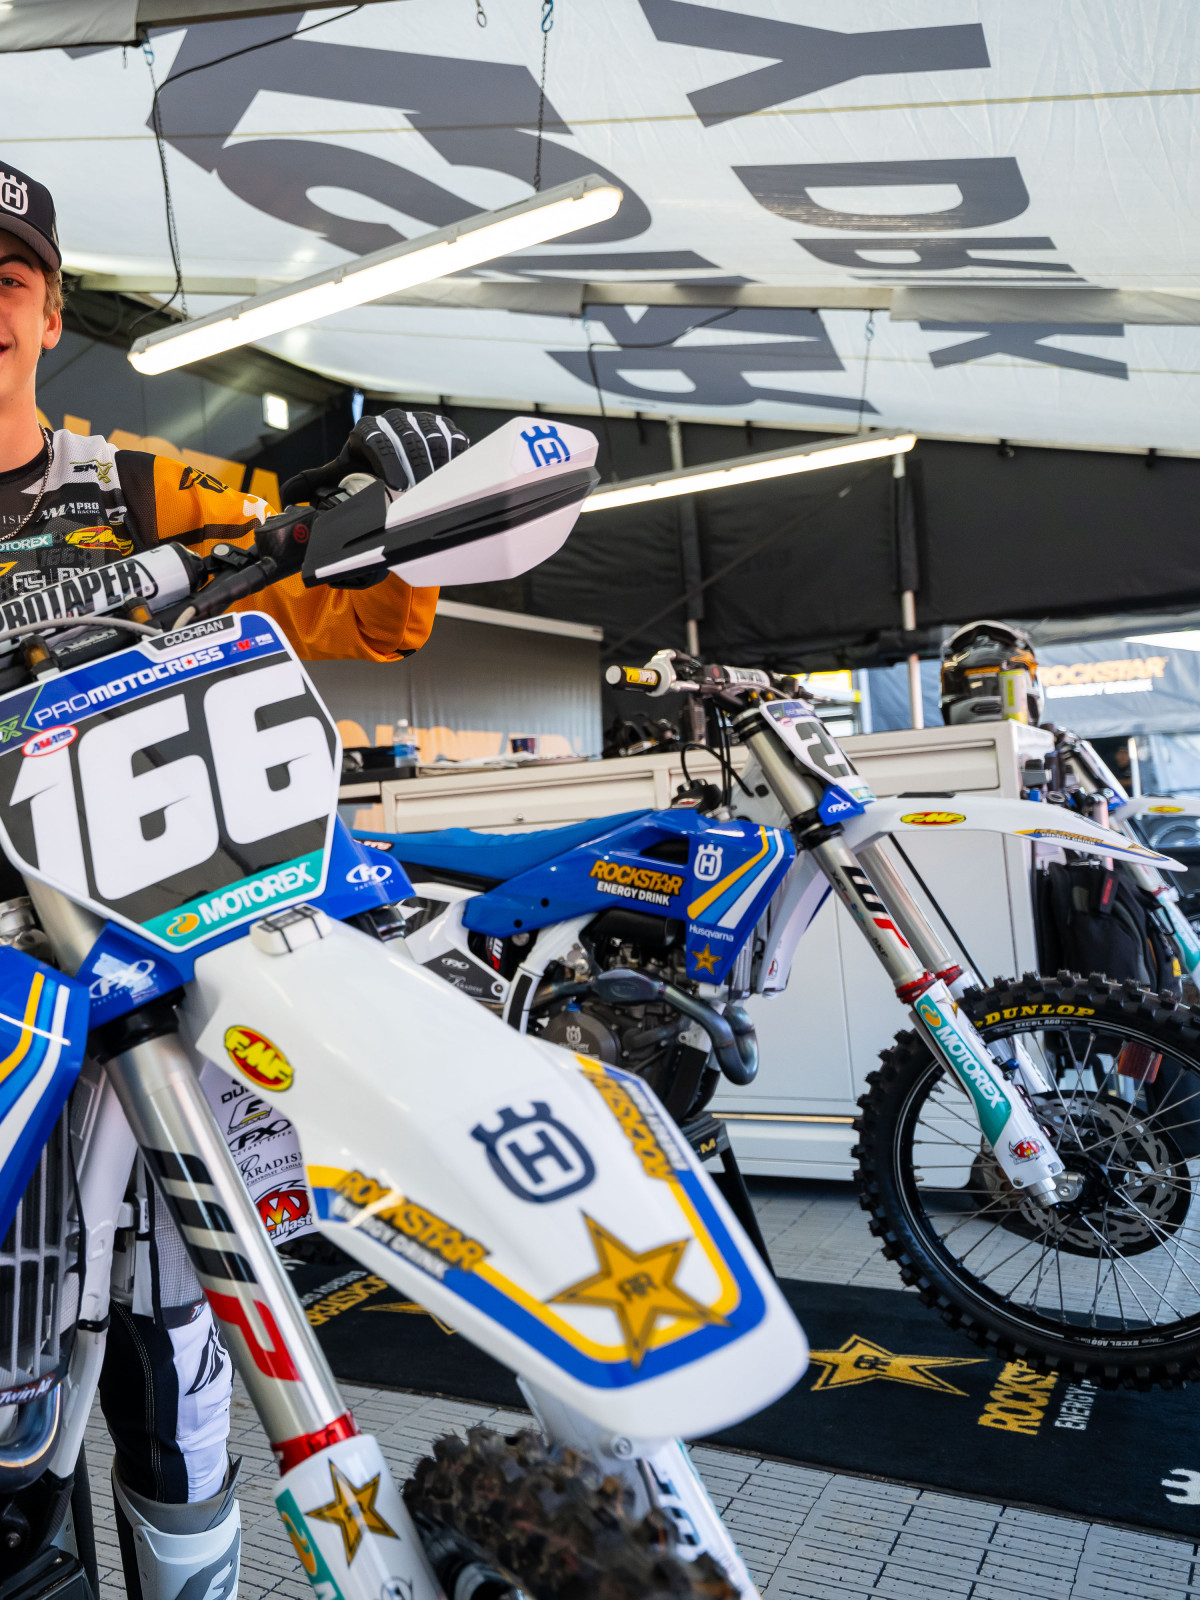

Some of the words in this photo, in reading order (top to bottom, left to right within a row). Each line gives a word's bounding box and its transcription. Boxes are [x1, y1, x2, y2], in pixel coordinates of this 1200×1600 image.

[163, 619, 224, 648] COCHRAN
[34, 645, 225, 726] PROMOTOCROSS
[9, 660, 334, 900] 166
[903, 812, 966, 825] FMF
[198, 862, 316, 926] MOTOREX
[590, 861, 685, 895] ROCKSTAR
[597, 880, 638, 898] ENERGY
[638, 890, 671, 906] DRINK
[689, 924, 734, 943] Husqvarna
[984, 1003, 1096, 1026] DUNLOP
[225, 1028, 294, 1083] FMF
[936, 1025, 1006, 1109] MOTOREX
[35, 1377, 54, 1396] Air
[1054, 1386, 1097, 1431] ENERGY
